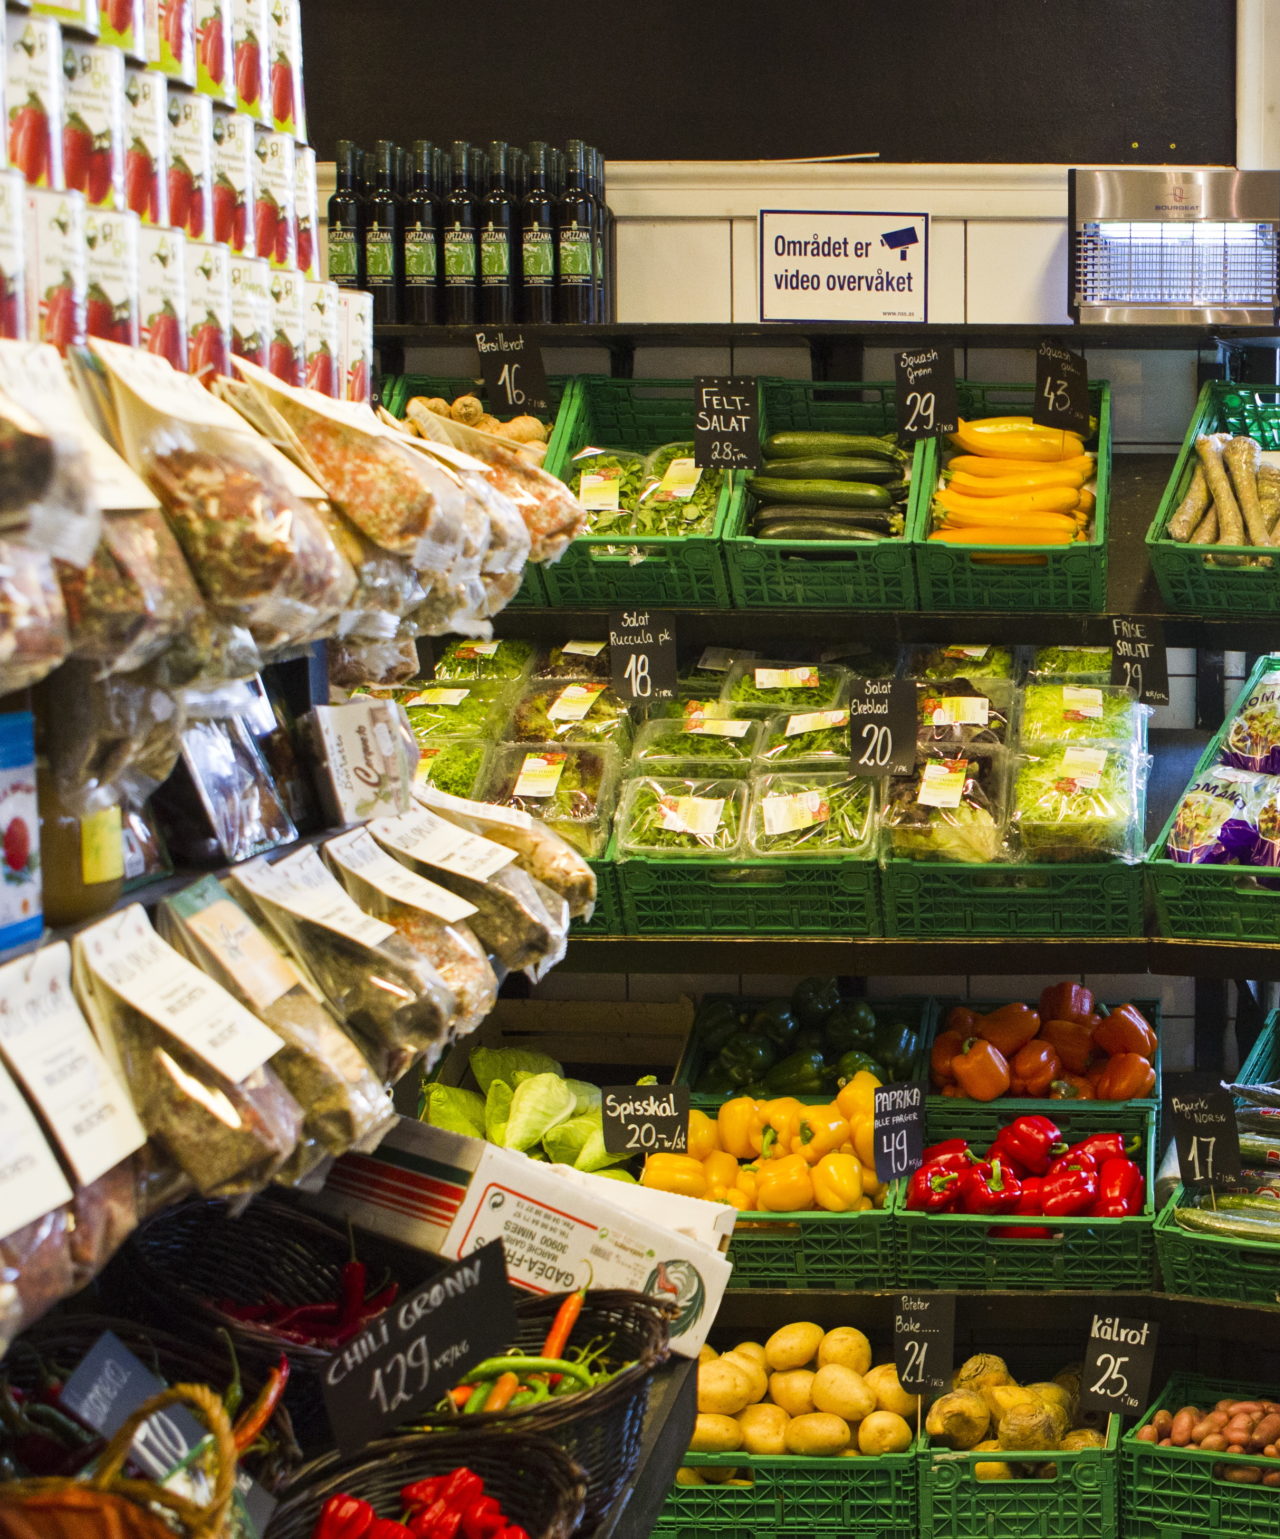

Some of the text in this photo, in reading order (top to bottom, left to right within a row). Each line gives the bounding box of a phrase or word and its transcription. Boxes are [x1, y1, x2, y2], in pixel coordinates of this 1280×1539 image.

[560, 230, 590, 241] CAPEZZANA
[774, 233, 872, 258] Området er
[774, 268, 913, 292] video overvåket
[900, 349, 938, 368] Squash
[1039, 342, 1071, 360] Squash
[498, 364, 525, 405] 16
[1043, 376, 1071, 412] 43
[702, 387, 750, 411] FELT-
[696, 411, 751, 433] SALAT
[621, 611, 650, 627] Salat
[1112, 617, 1147, 639] FRISE
[610, 629, 654, 646] Ruccula
[1116, 639, 1155, 658] SALAT
[624, 653, 652, 697] 18
[864, 679, 892, 695] Salat
[850, 698, 889, 716] Ekeblad
[1189, 782, 1248, 810] OMANO
[605, 1092, 679, 1124] Spisskål
[875, 1084, 920, 1113] PAPRIKA
[1172, 1097, 1208, 1119] Agurk
[874, 1111, 918, 1130] ALLE FARGER
[1193, 1113, 1226, 1124] NORSK
[883, 1129, 908, 1173] 49
[1187, 1135, 1216, 1181] 17
[503, 1220, 569, 1254] 30900 NIMES
[901, 1295, 930, 1311] Poteter
[327, 1319, 390, 1385] CHILI
[901, 1340, 929, 1383] 21
[369, 1335, 430, 1413] 129
